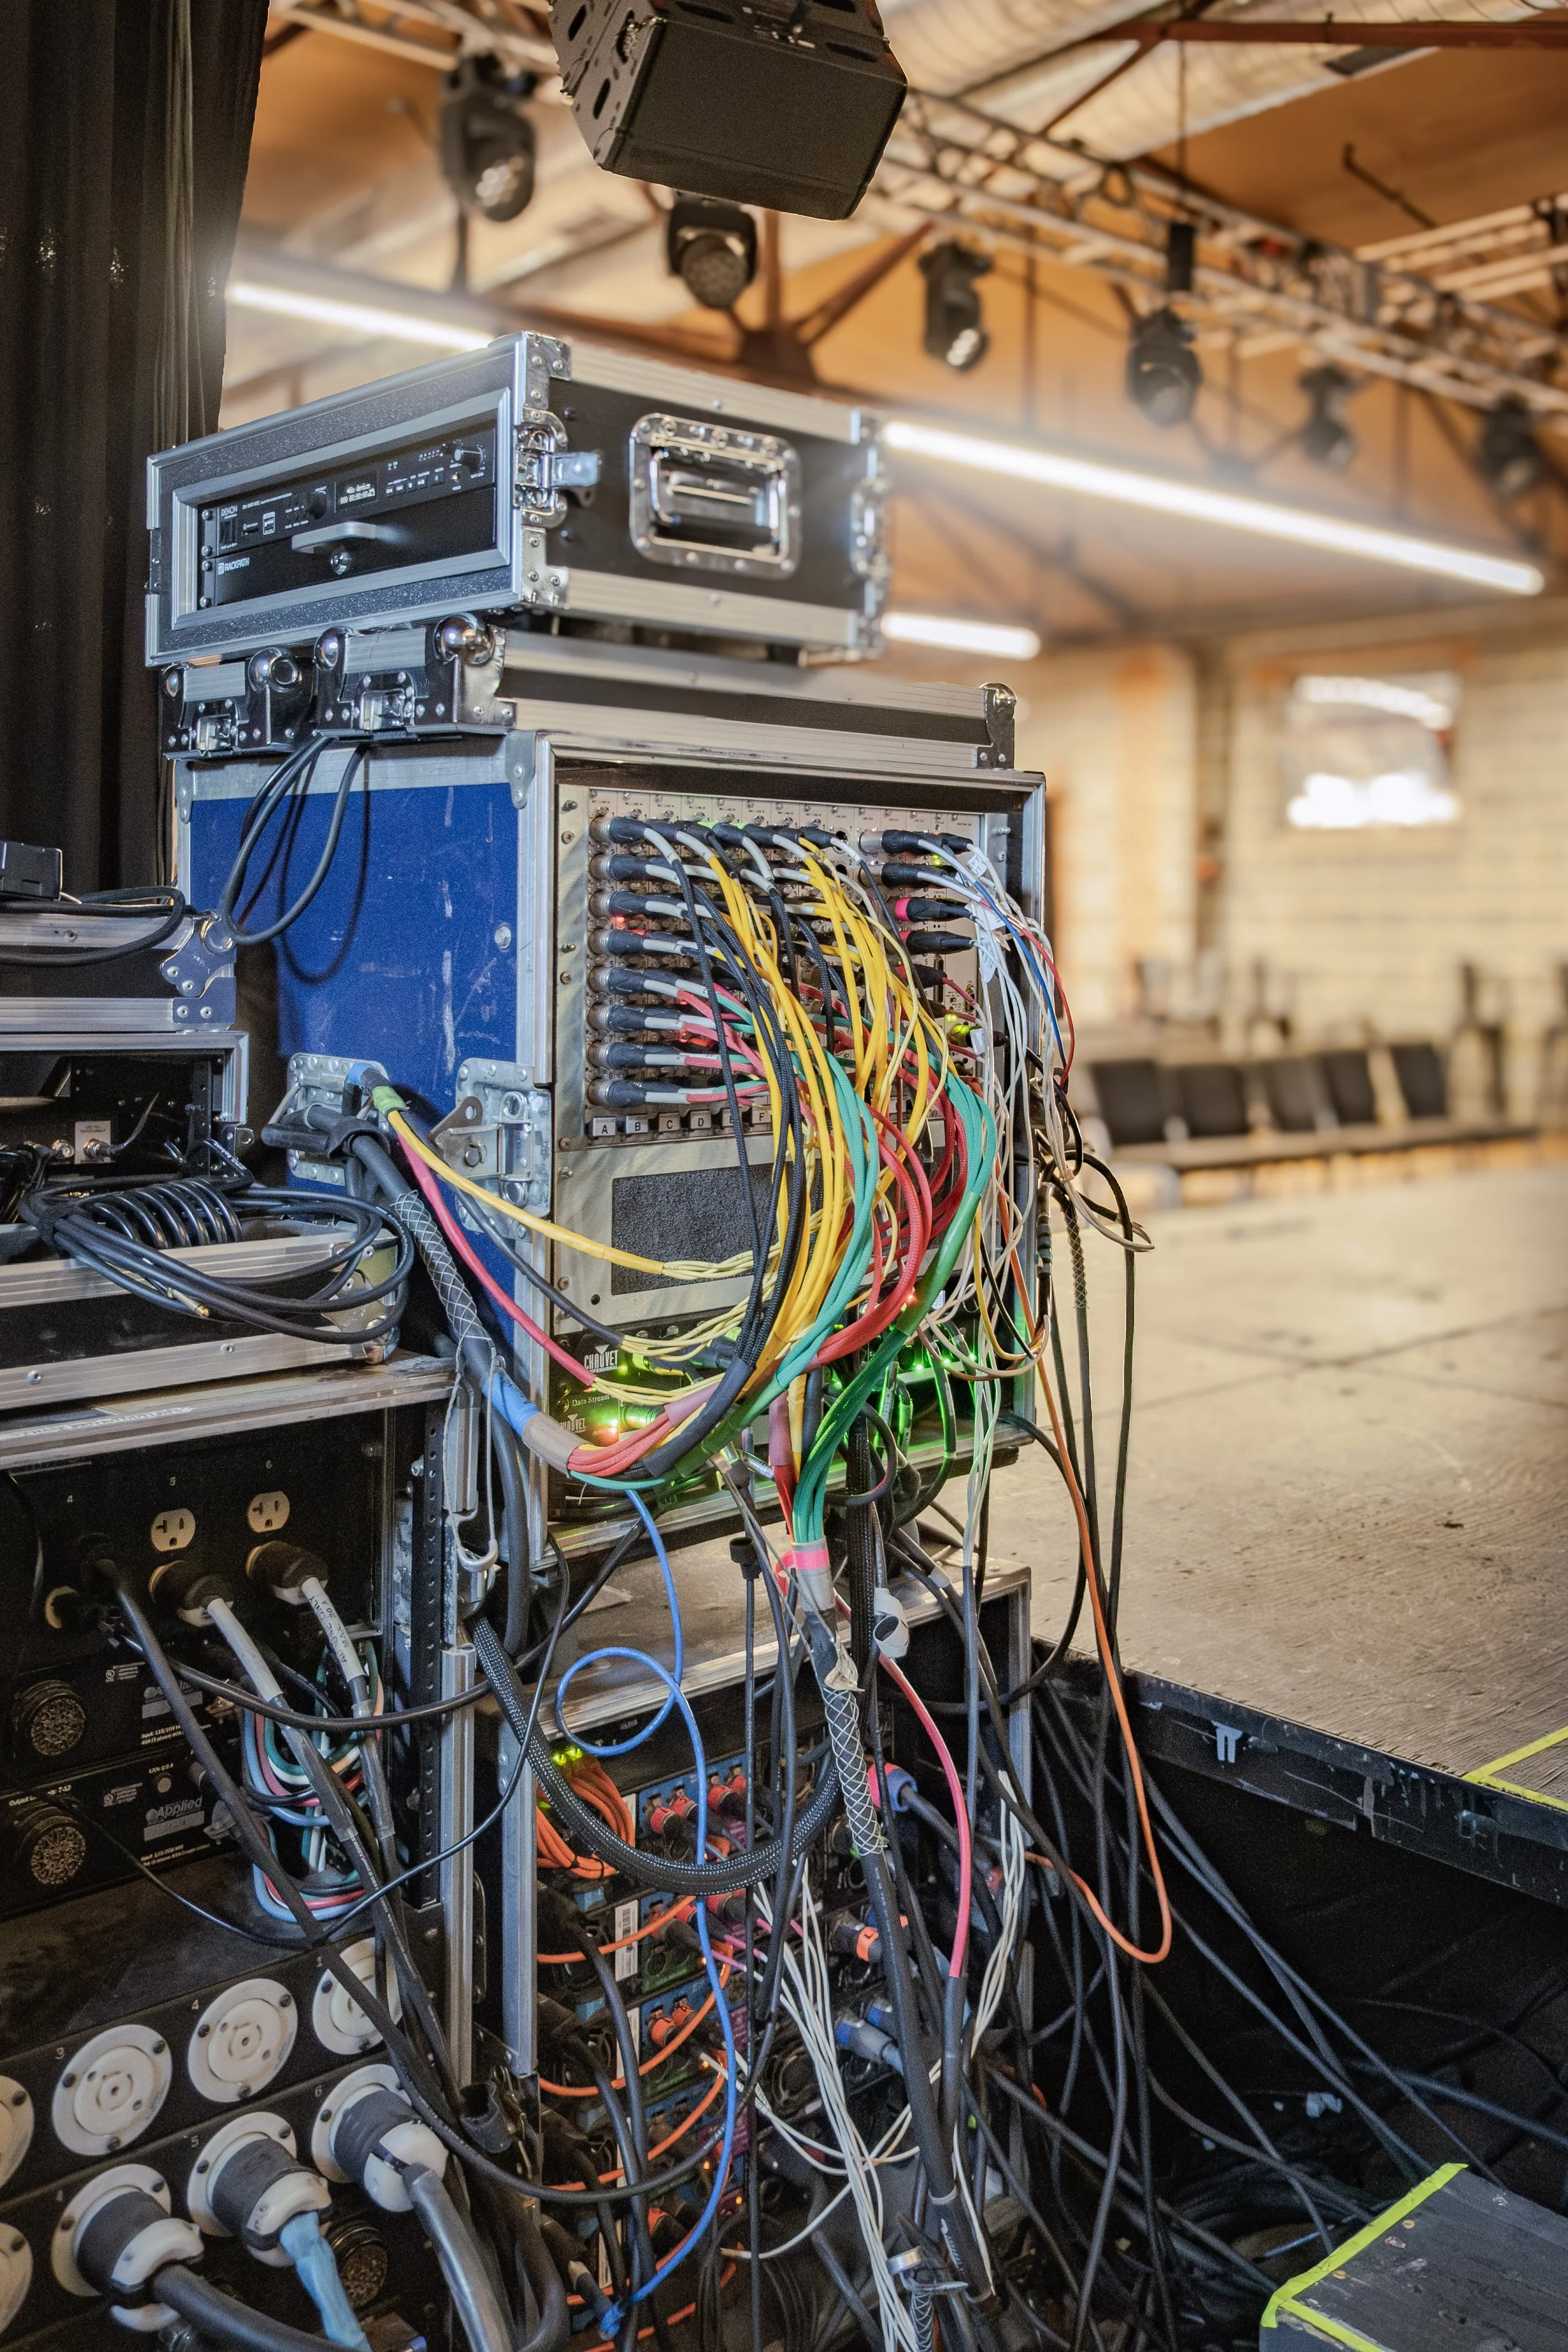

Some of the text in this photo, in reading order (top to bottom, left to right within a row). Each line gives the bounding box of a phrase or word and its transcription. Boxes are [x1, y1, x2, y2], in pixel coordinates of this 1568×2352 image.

[221, 505, 238, 517] DENON
[224, 557, 250, 571] RACKPATH
[698, 1118, 704, 1127] D
[760, 1112, 765, 1121] F
[601, 1125, 608, 1134] A
[635, 1121, 640, 1131] B
[666, 1120, 673, 1130] C
[584, 1350, 618, 1370] CHAUVET
[572, 1394, 610, 1407] Data Stream
[66, 1495, 73, 1503] 4
[309, 1596, 326, 1621] ONLY
[157, 1795, 203, 1819] Applied
[316, 1956, 324, 1968] 1
[191, 1999, 199, 2011] 4
[191, 2134, 199, 2148] 5
